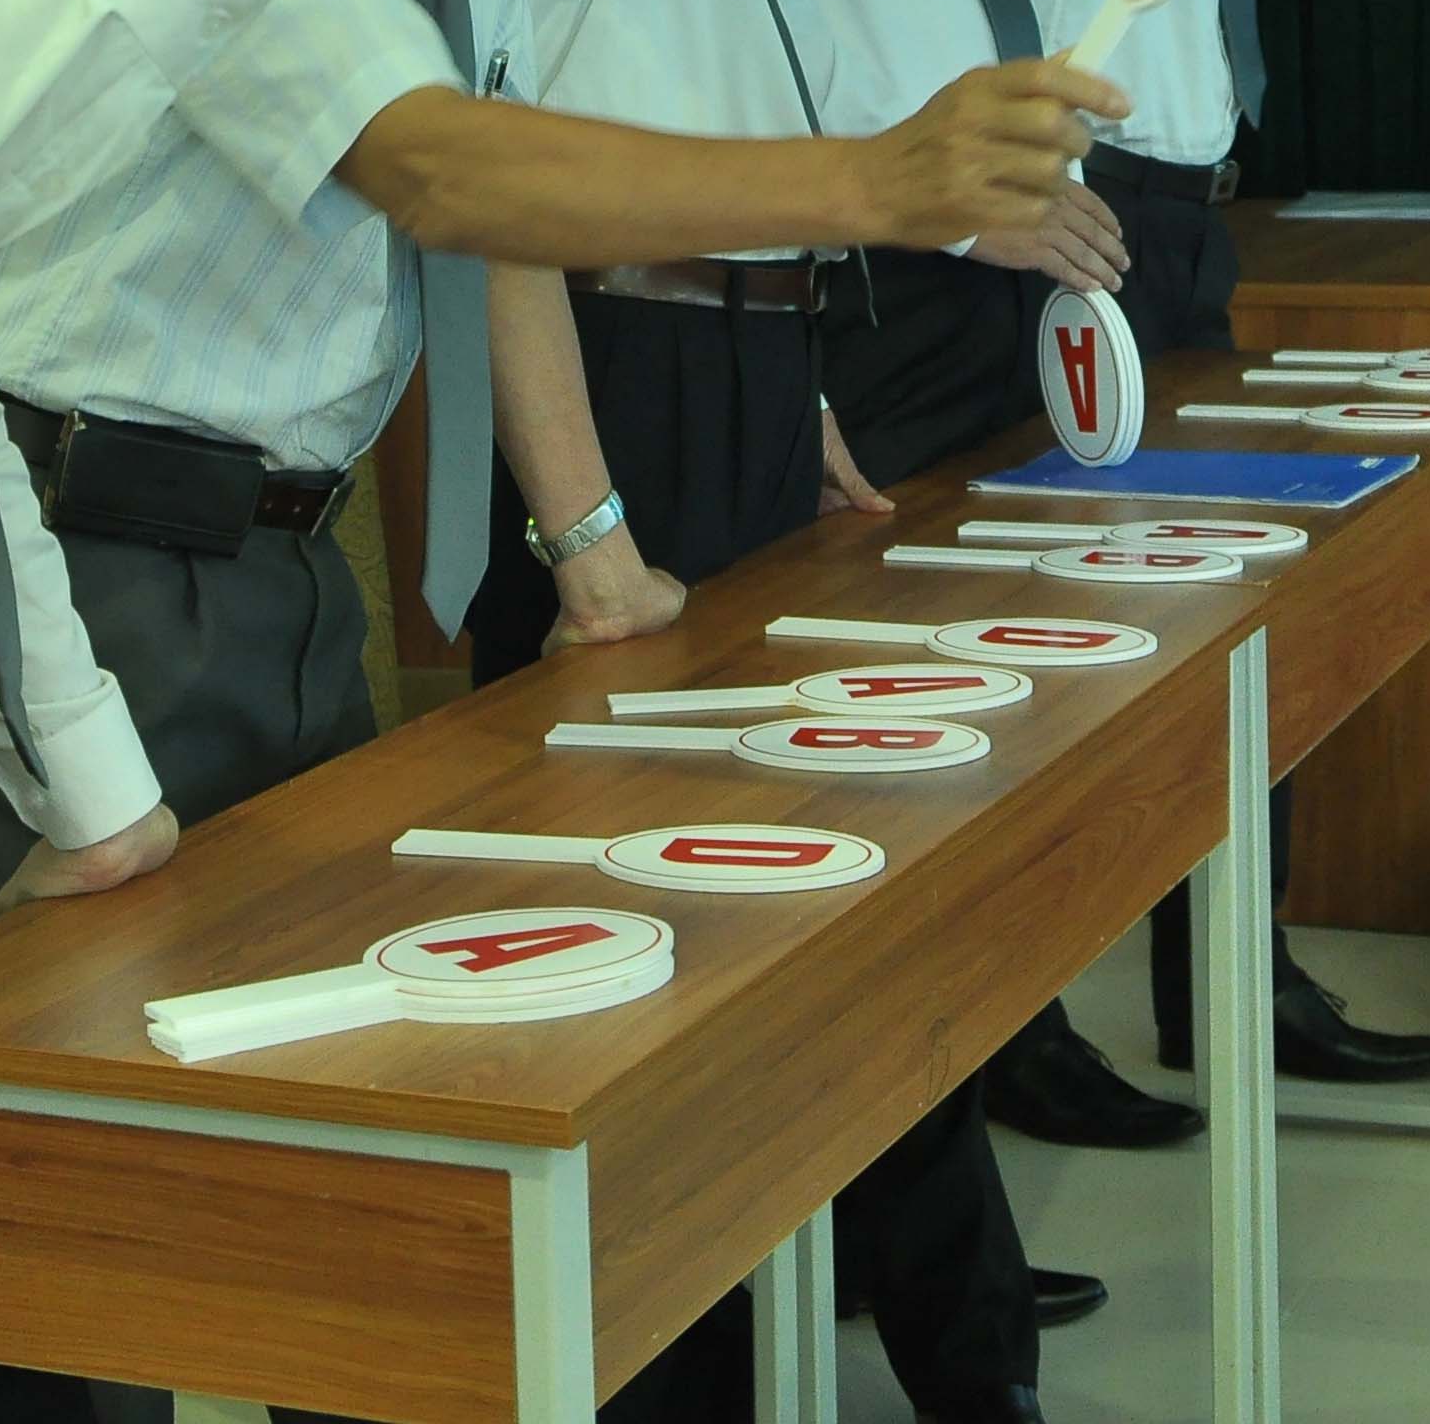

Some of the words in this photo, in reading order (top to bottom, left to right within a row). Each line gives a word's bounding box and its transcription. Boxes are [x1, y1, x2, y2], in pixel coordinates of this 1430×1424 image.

[1056, 326, 1098, 433] A
[1145, 524, 1269, 539] A
[977, 626, 1118, 650] D
[838, 676, 987, 699] A
[788, 727, 944, 751] B
[659, 836, 837, 868] D
[417, 922, 617, 974] A
